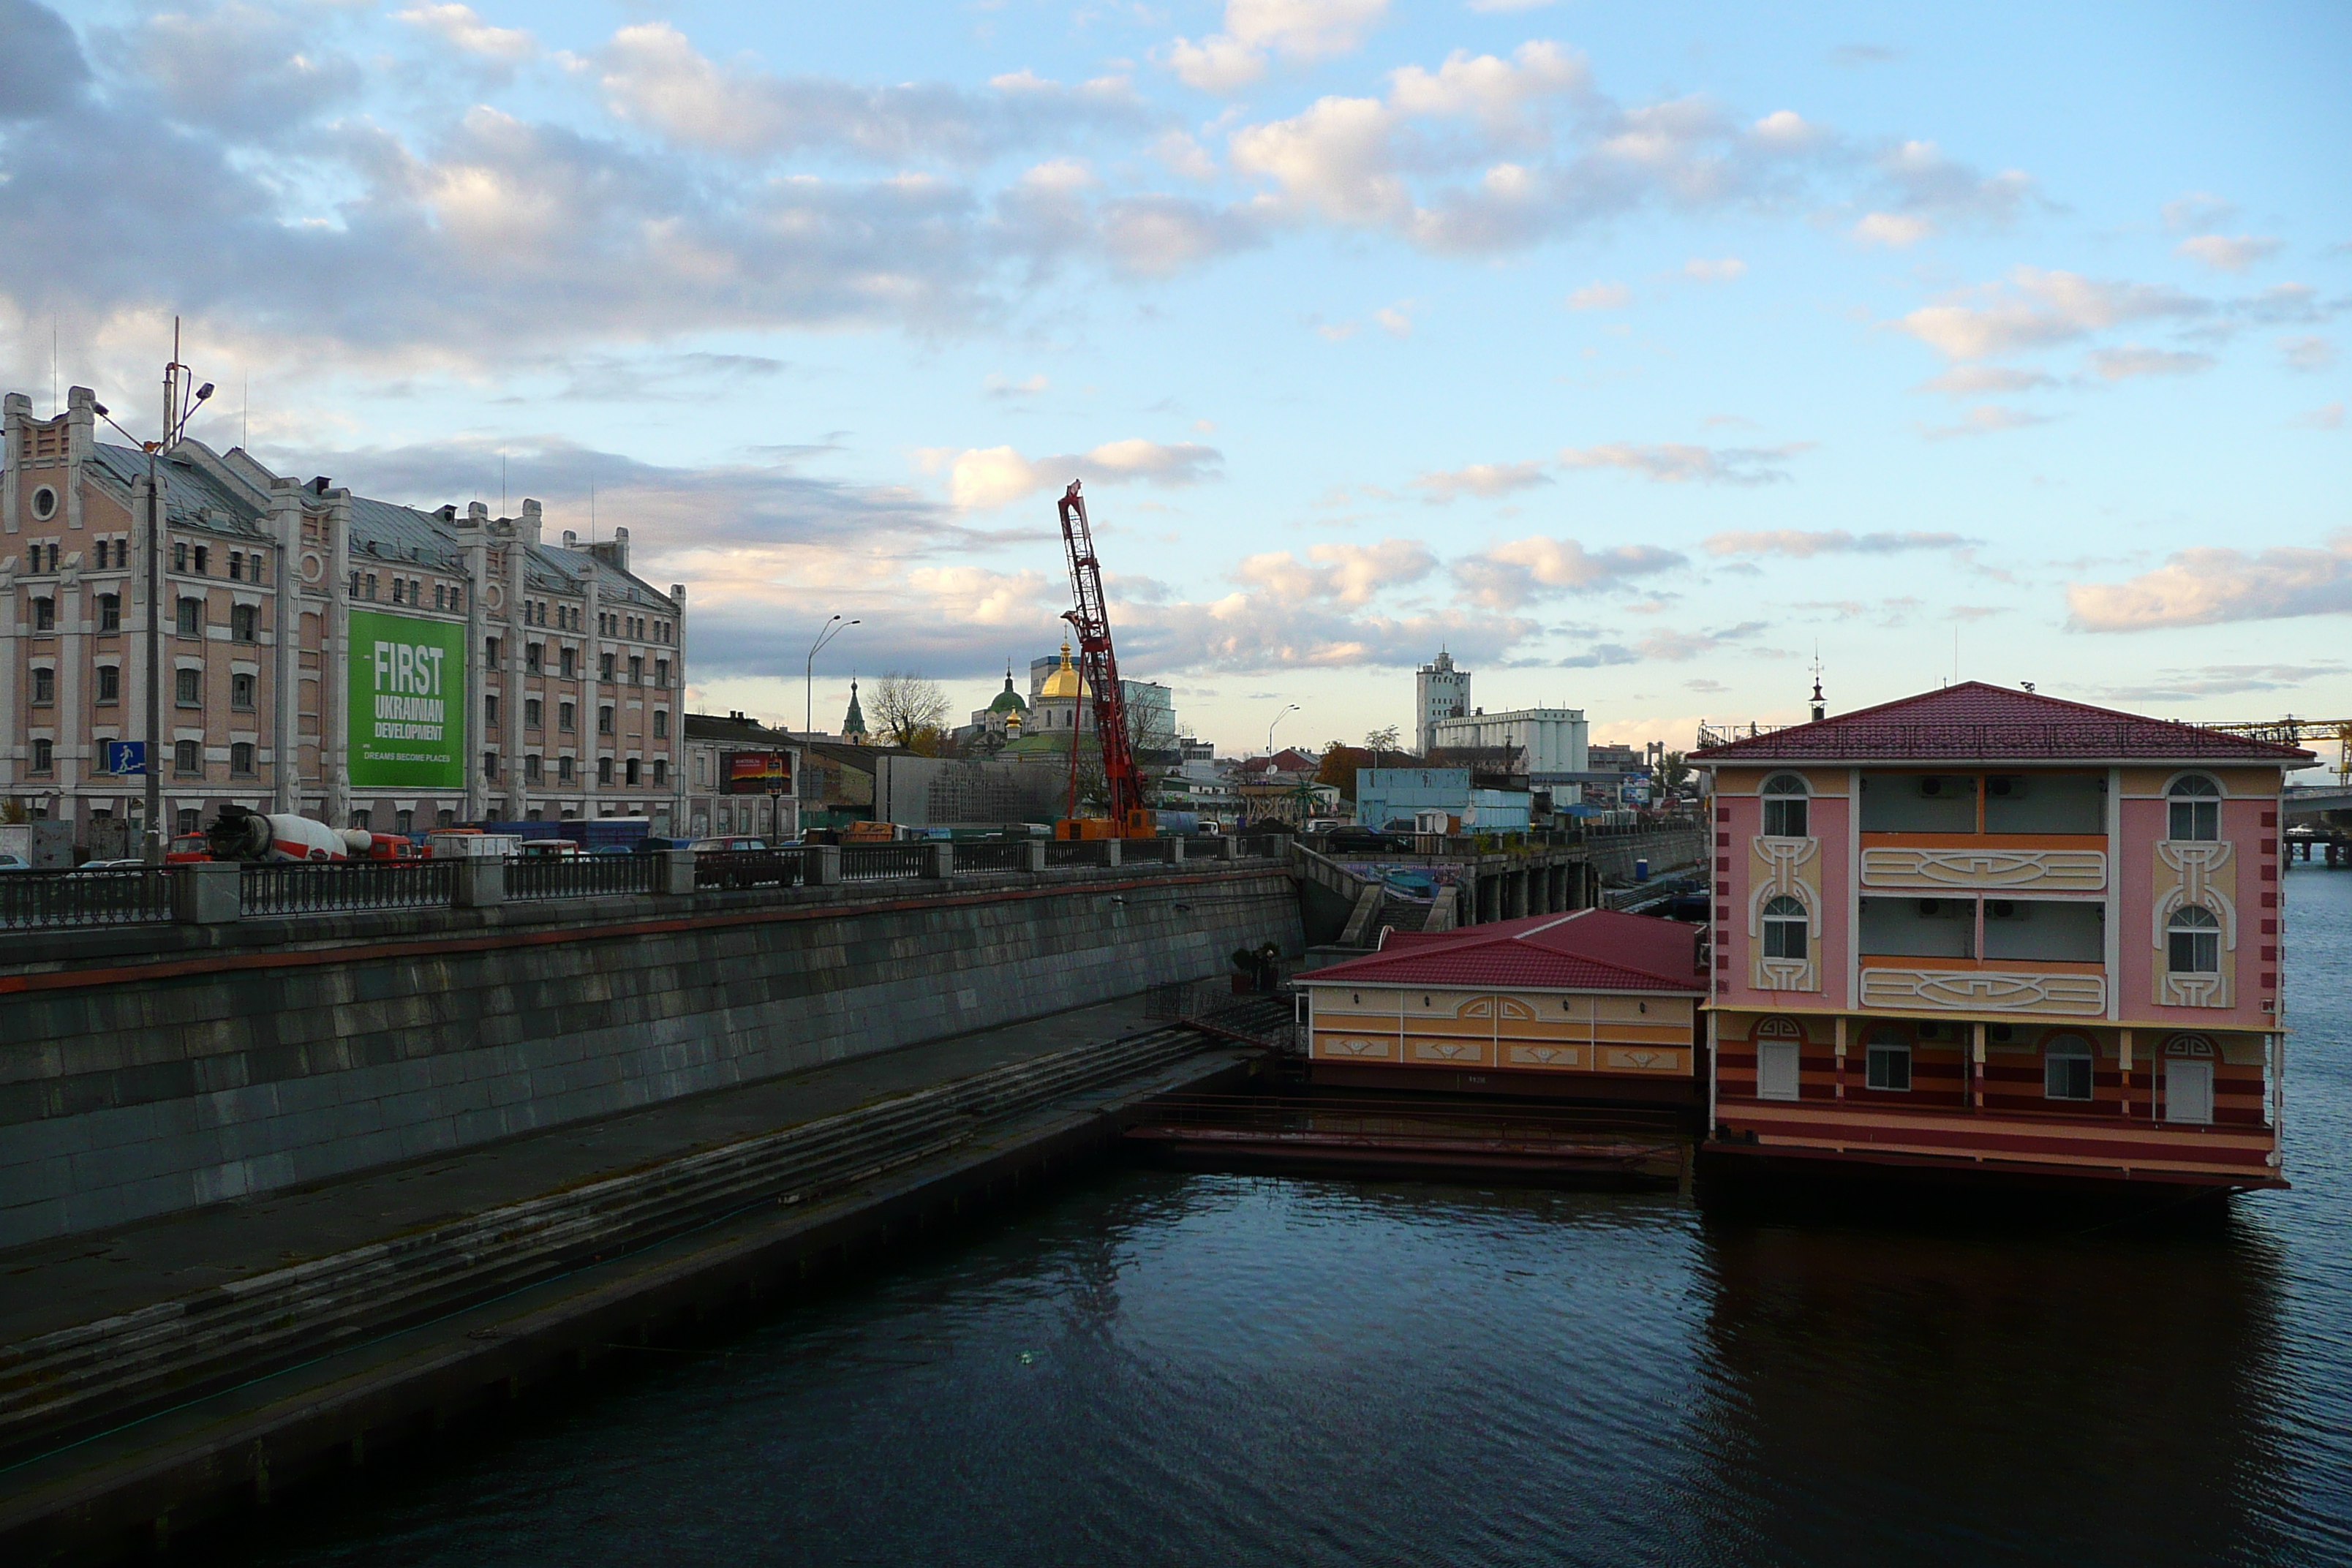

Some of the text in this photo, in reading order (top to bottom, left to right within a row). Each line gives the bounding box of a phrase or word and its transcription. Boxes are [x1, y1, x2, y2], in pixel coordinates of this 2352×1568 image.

[374, 641, 444, 696] FIRST
[374, 695, 444, 723] UKRAINIAN
[374, 722, 443, 741] DEVELOPMENT
[364, 751, 451, 762] DREAMS BECOME PLACES
